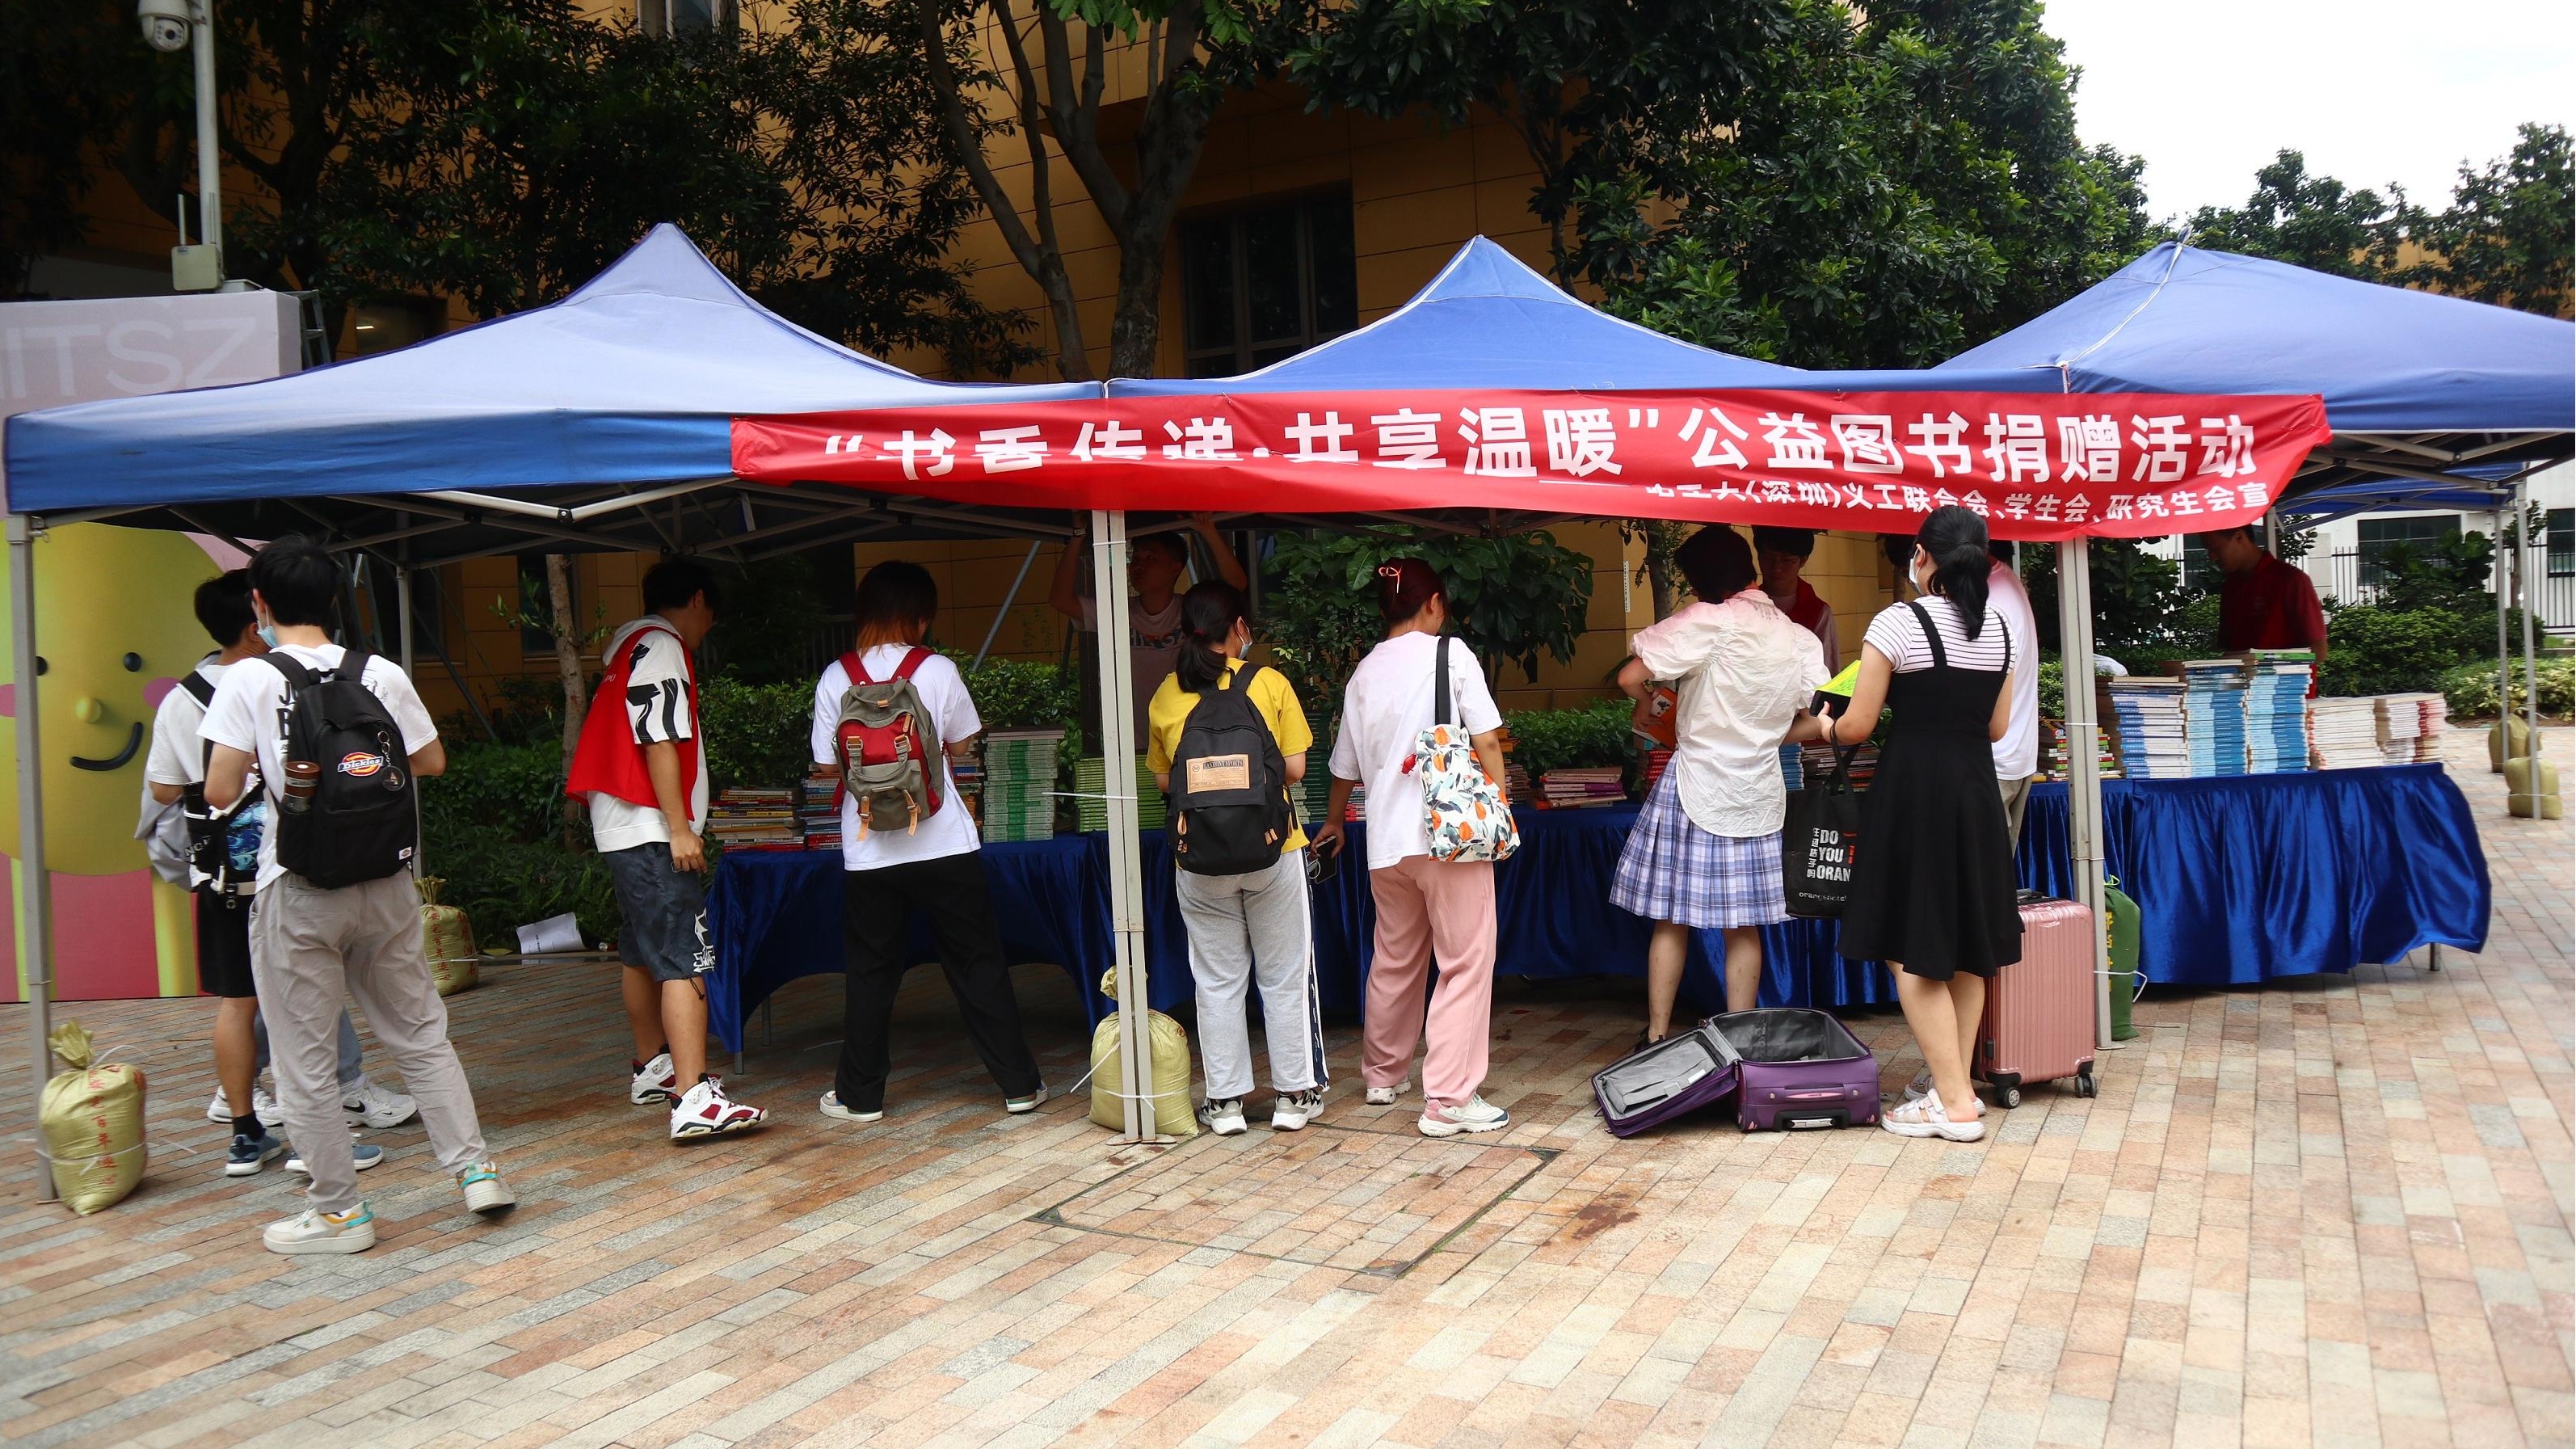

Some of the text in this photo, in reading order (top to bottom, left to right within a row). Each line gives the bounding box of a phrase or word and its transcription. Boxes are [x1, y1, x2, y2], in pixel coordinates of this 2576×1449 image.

[342, 756, 382, 771] Dickies
[1820, 829, 1839, 845] DO
[1818, 846, 1844, 863] YOU
